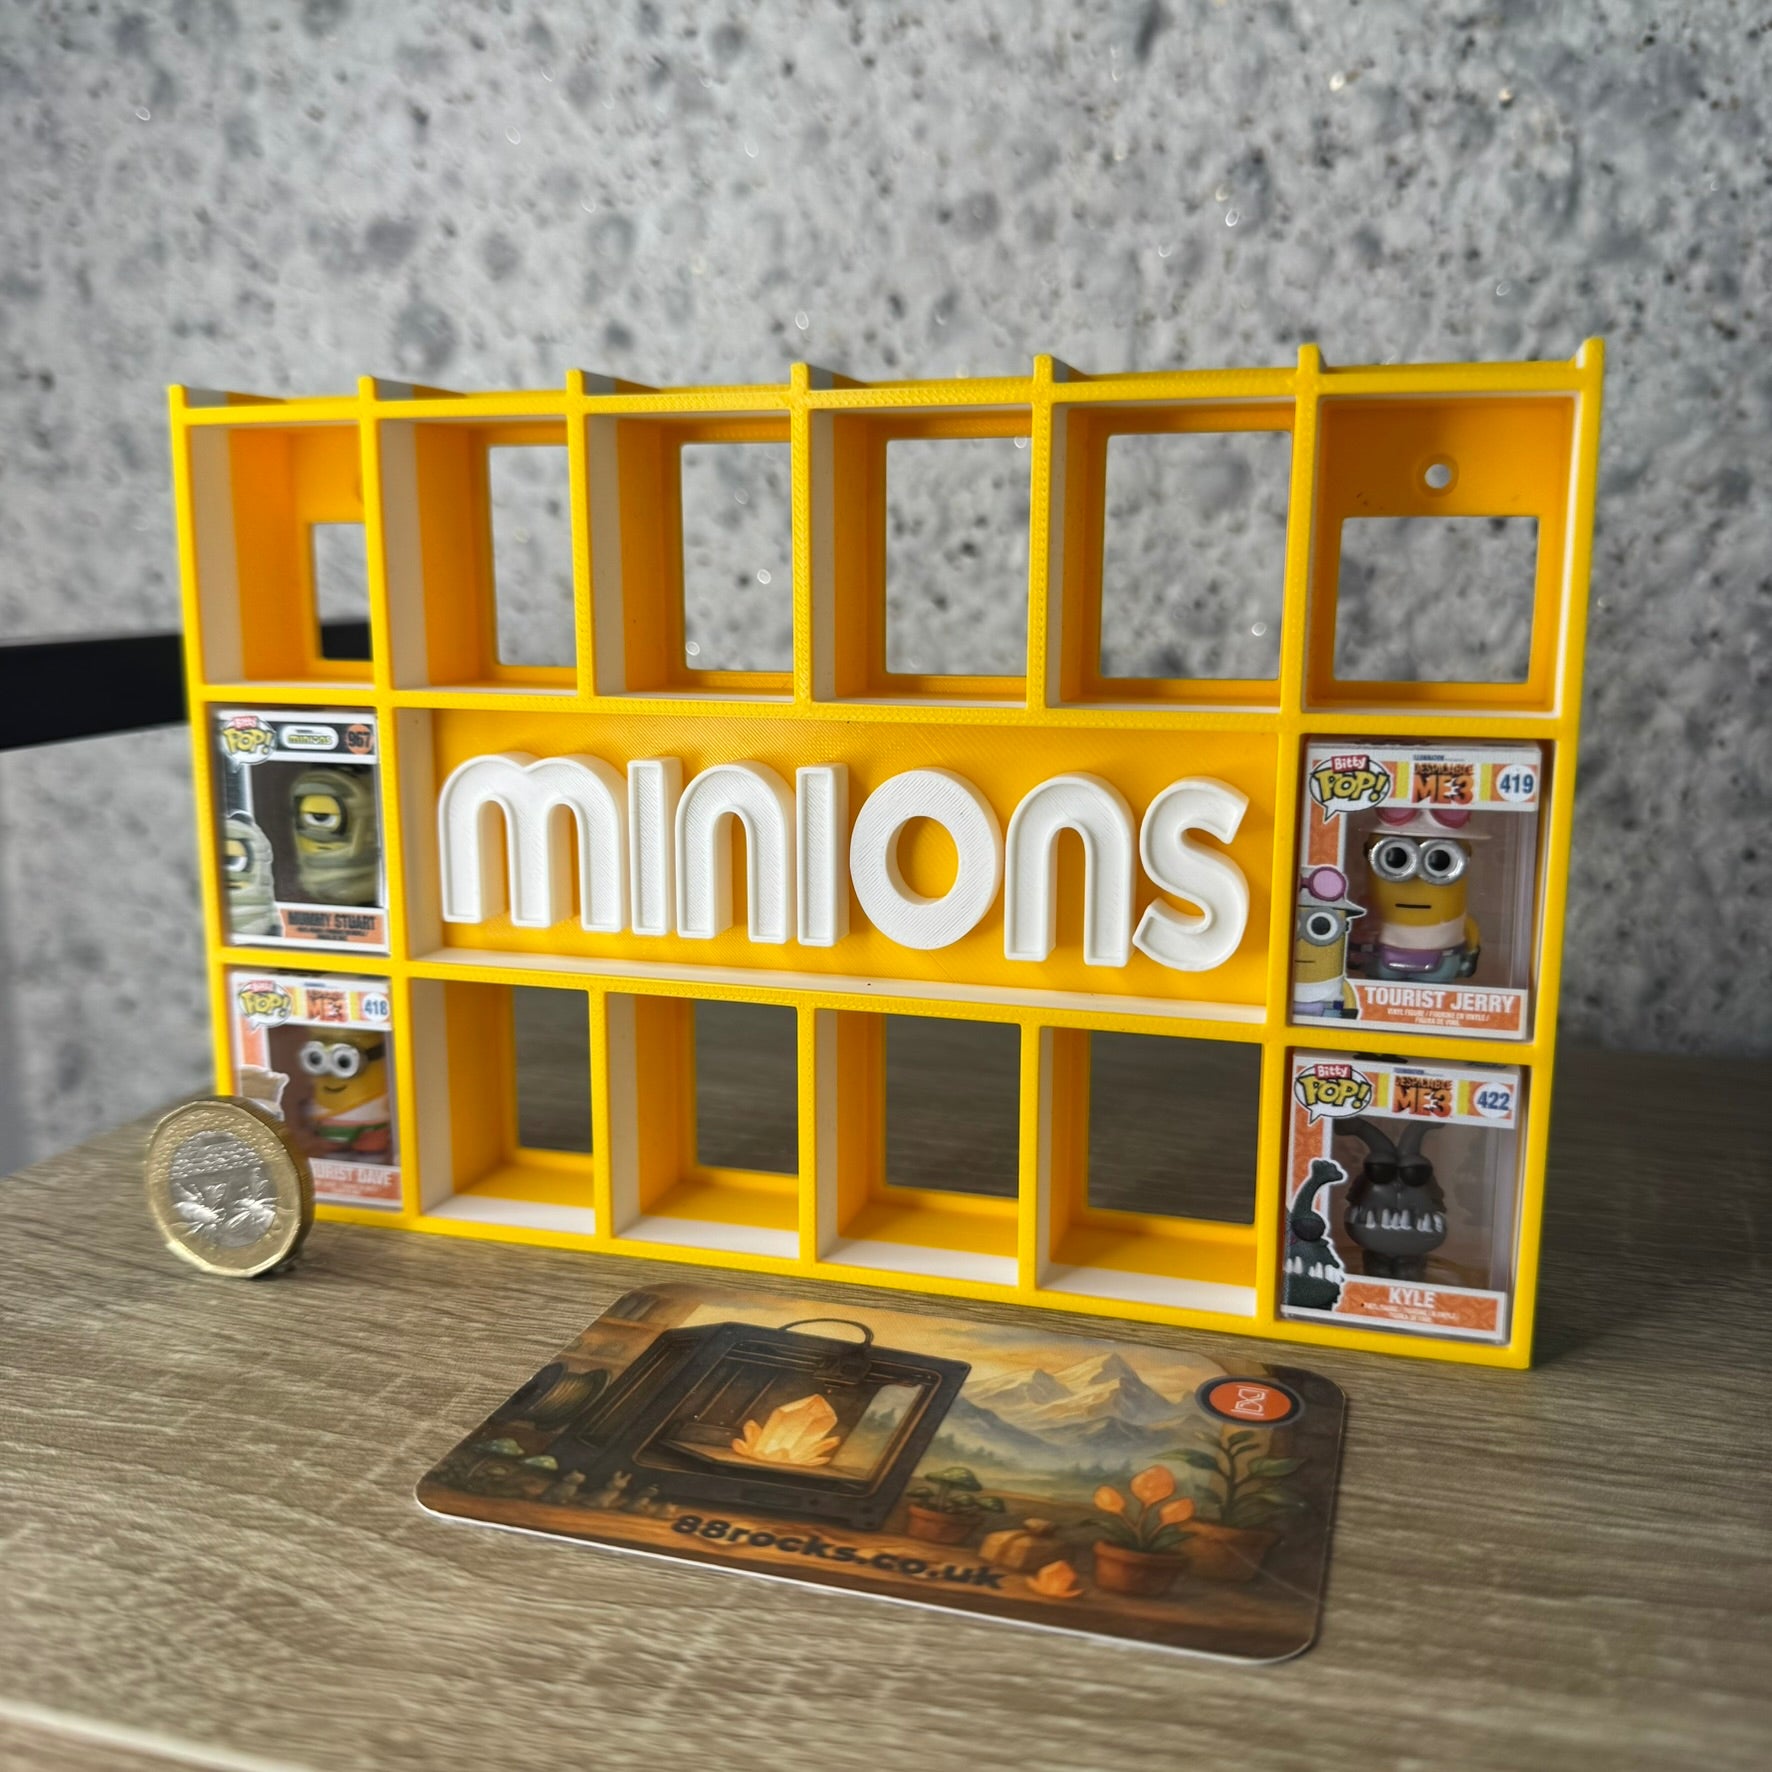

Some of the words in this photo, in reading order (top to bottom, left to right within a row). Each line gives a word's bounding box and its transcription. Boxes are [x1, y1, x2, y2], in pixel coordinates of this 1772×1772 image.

[348, 730, 372, 748] 967
[1334, 757, 1367, 771] Bitty
[1500, 773, 1534, 794] 419
[364, 999, 388, 1016] 418
[1364, 986, 1447, 1009] TOURIST
[1450, 991, 1515, 1013] JERRY
[1316, 1065, 1349, 1079] Bitty
[1477, 1091, 1510, 1111] 422
[1389, 1286, 1437, 1309] KYLE
[671, 1514, 1009, 1590] 88rocks.co.uk
